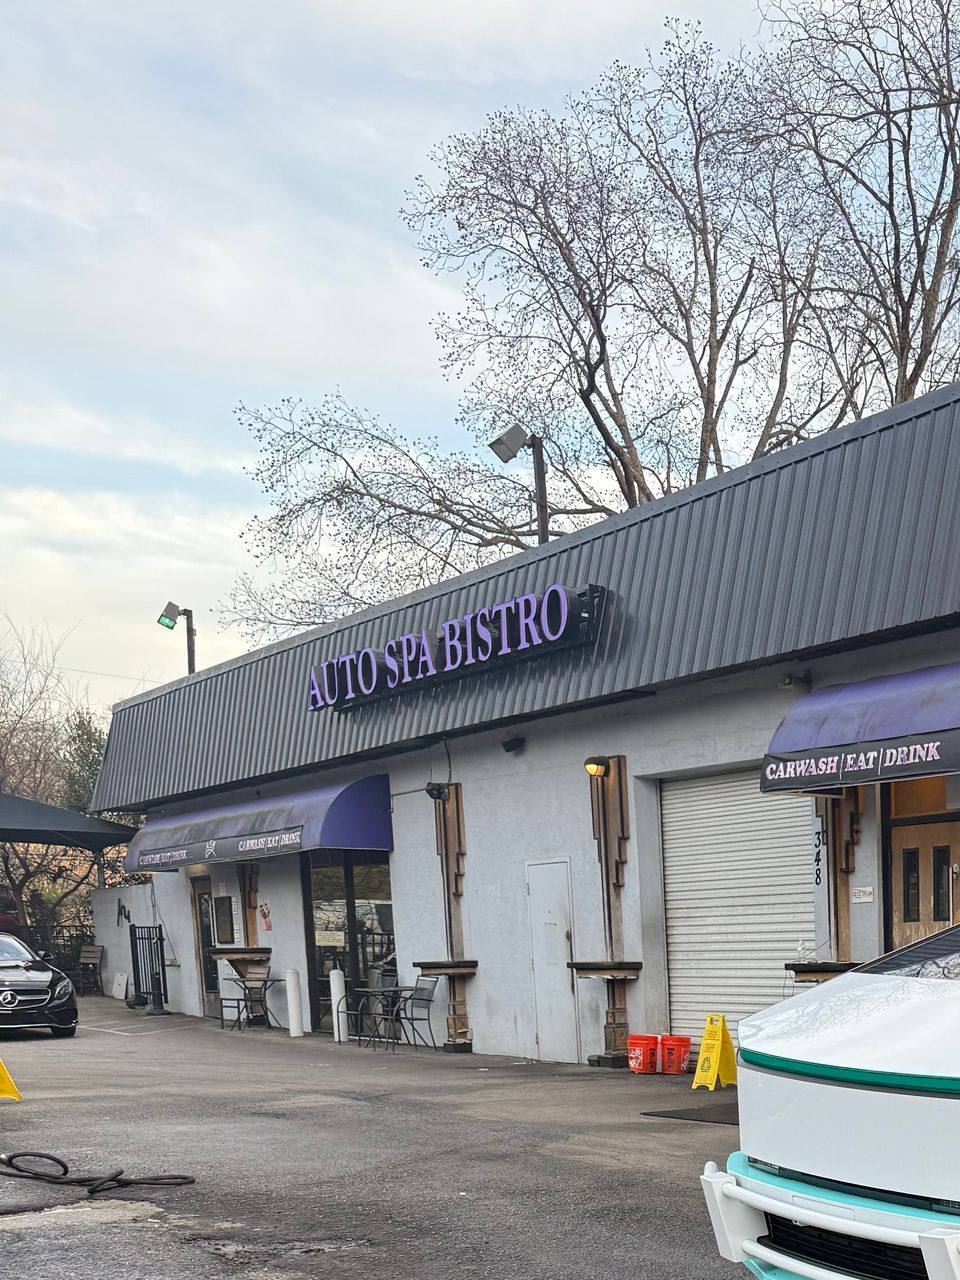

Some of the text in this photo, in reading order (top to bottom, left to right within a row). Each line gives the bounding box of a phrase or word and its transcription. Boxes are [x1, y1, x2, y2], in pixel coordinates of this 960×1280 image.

[307, 584, 568, 711] AUTO SPA BISTRO
[765, 742, 941, 780] CARWASH EAT DRINK
[267, 836, 280, 848] EAT
[814, 831, 822, 886] 348
